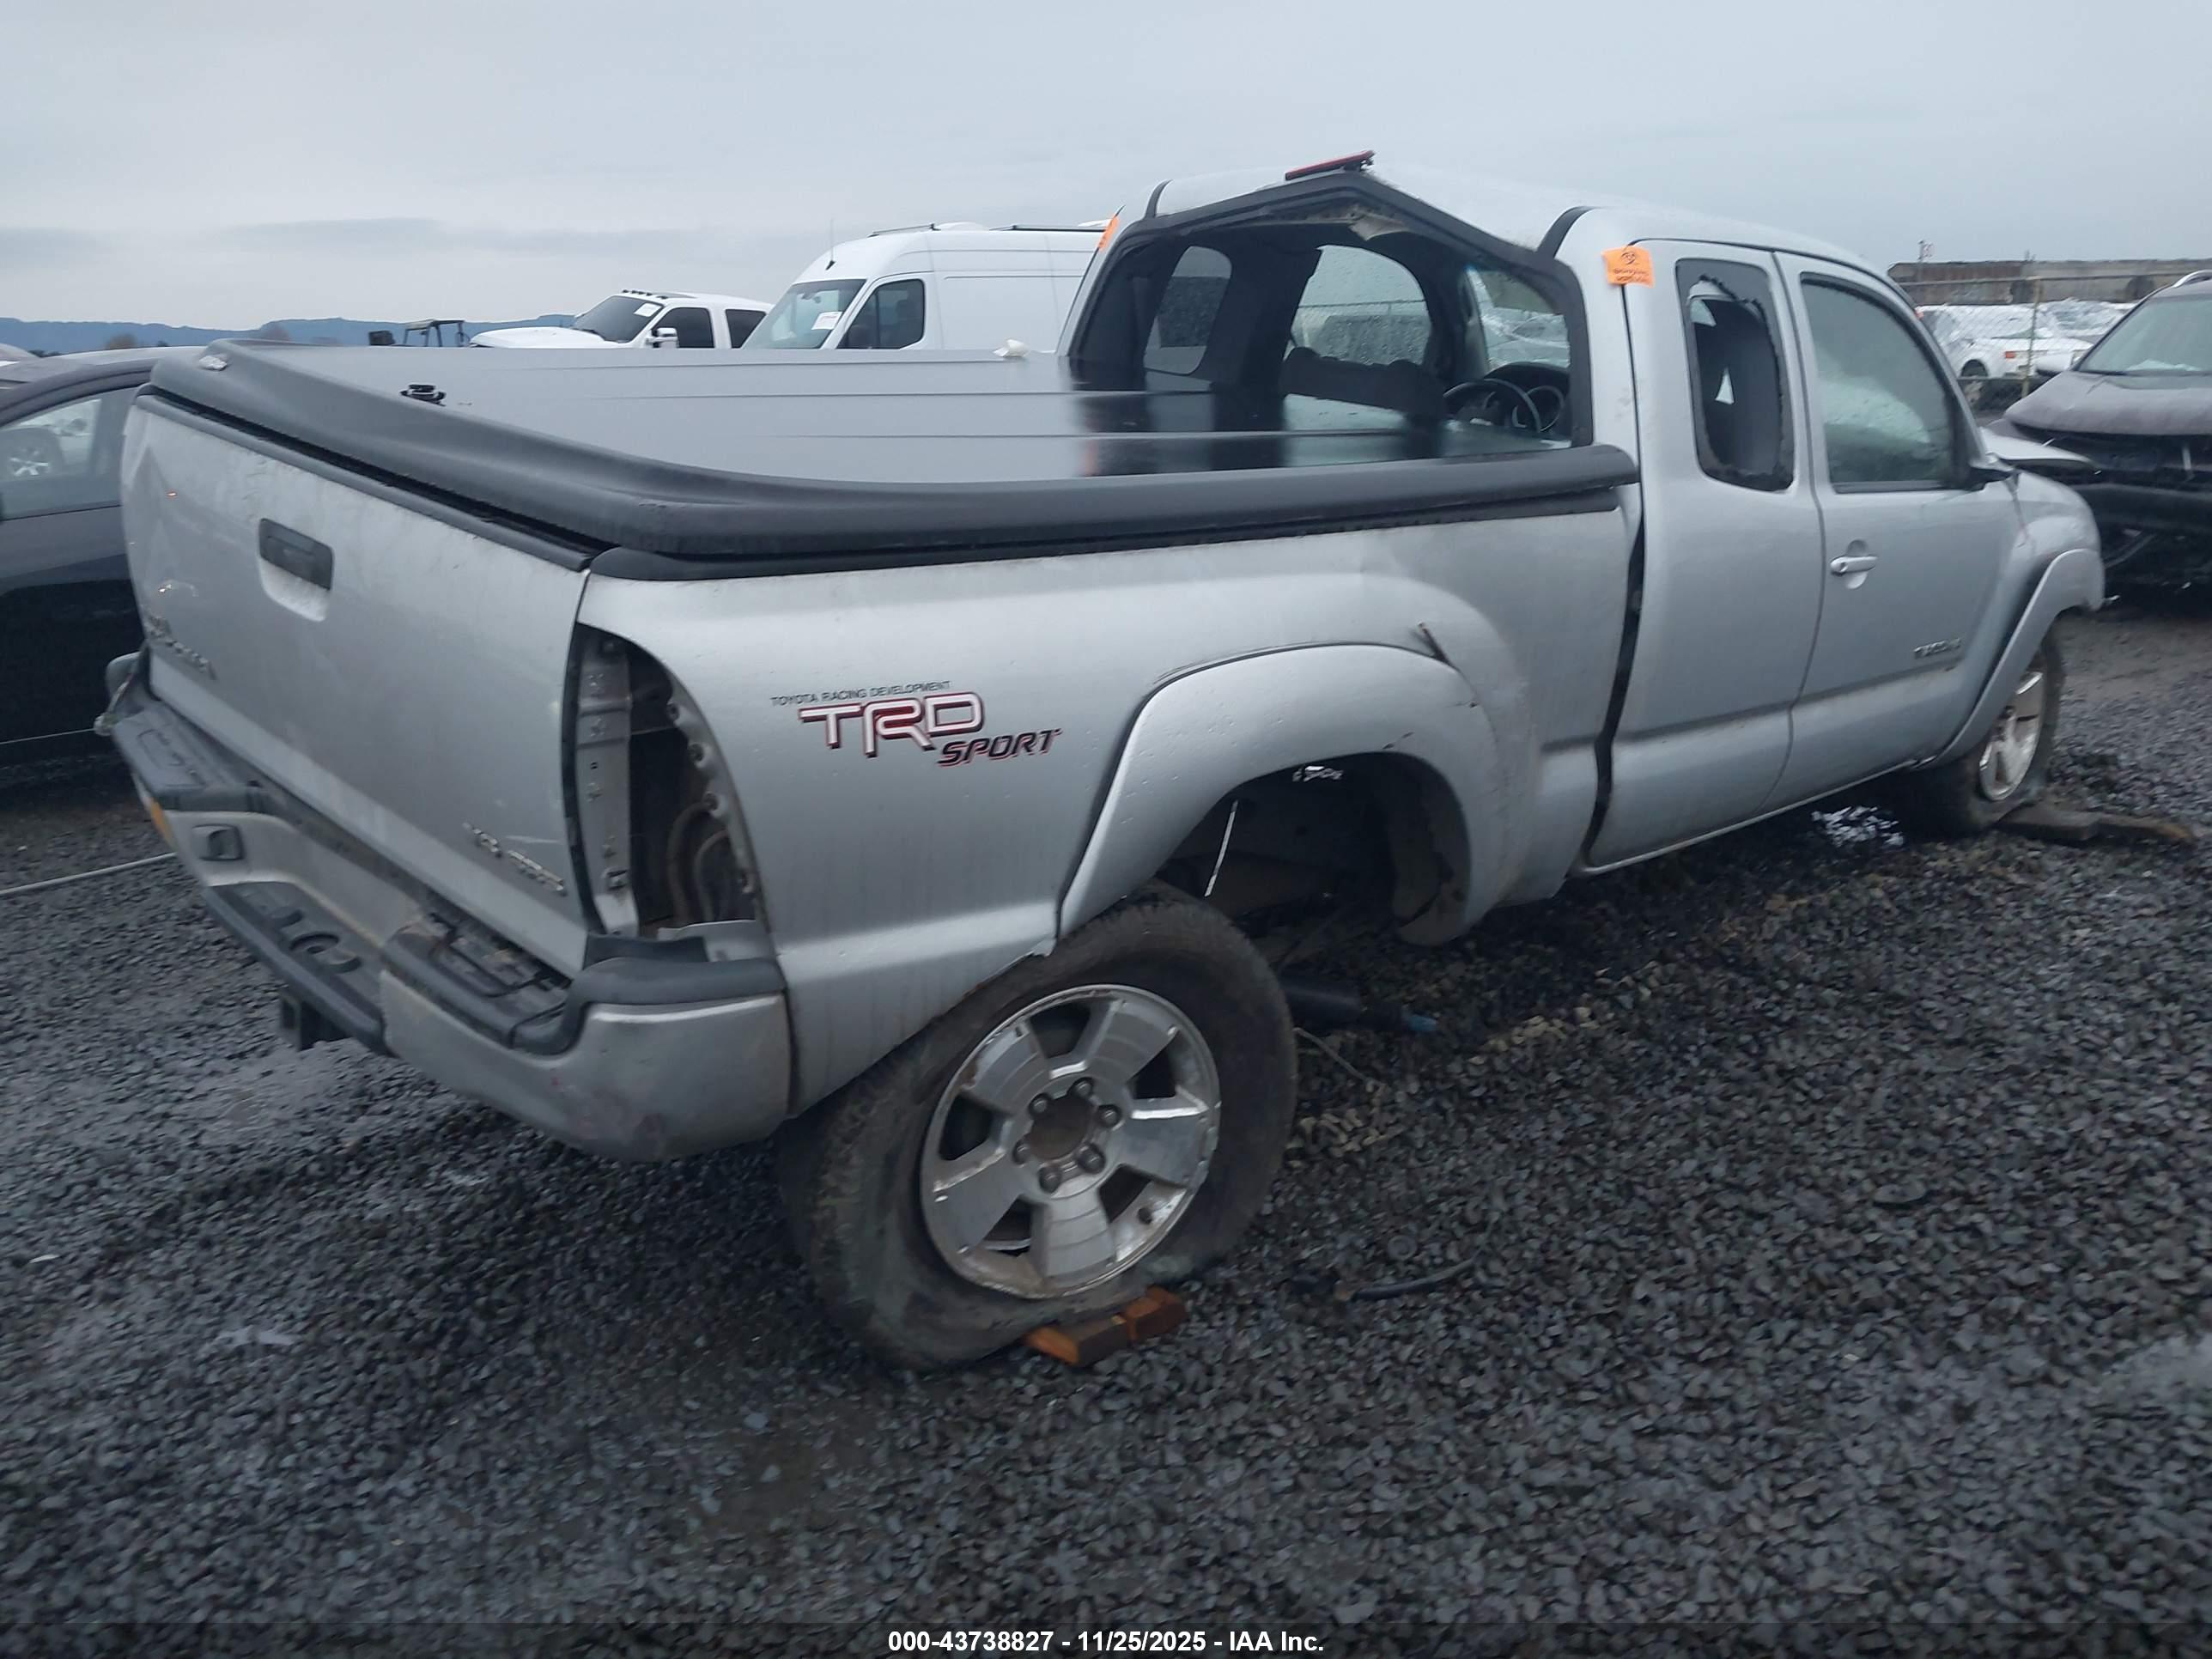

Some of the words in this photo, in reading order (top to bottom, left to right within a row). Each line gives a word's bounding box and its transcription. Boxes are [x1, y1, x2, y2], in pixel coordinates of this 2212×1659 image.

[770, 693, 818, 707] TOYOTA
[821, 688, 867, 702] RACING
[869, 680, 951, 697] DEVELOPMENT
[798, 691, 985, 758] TRD
[937, 727, 1063, 767] SPORT
